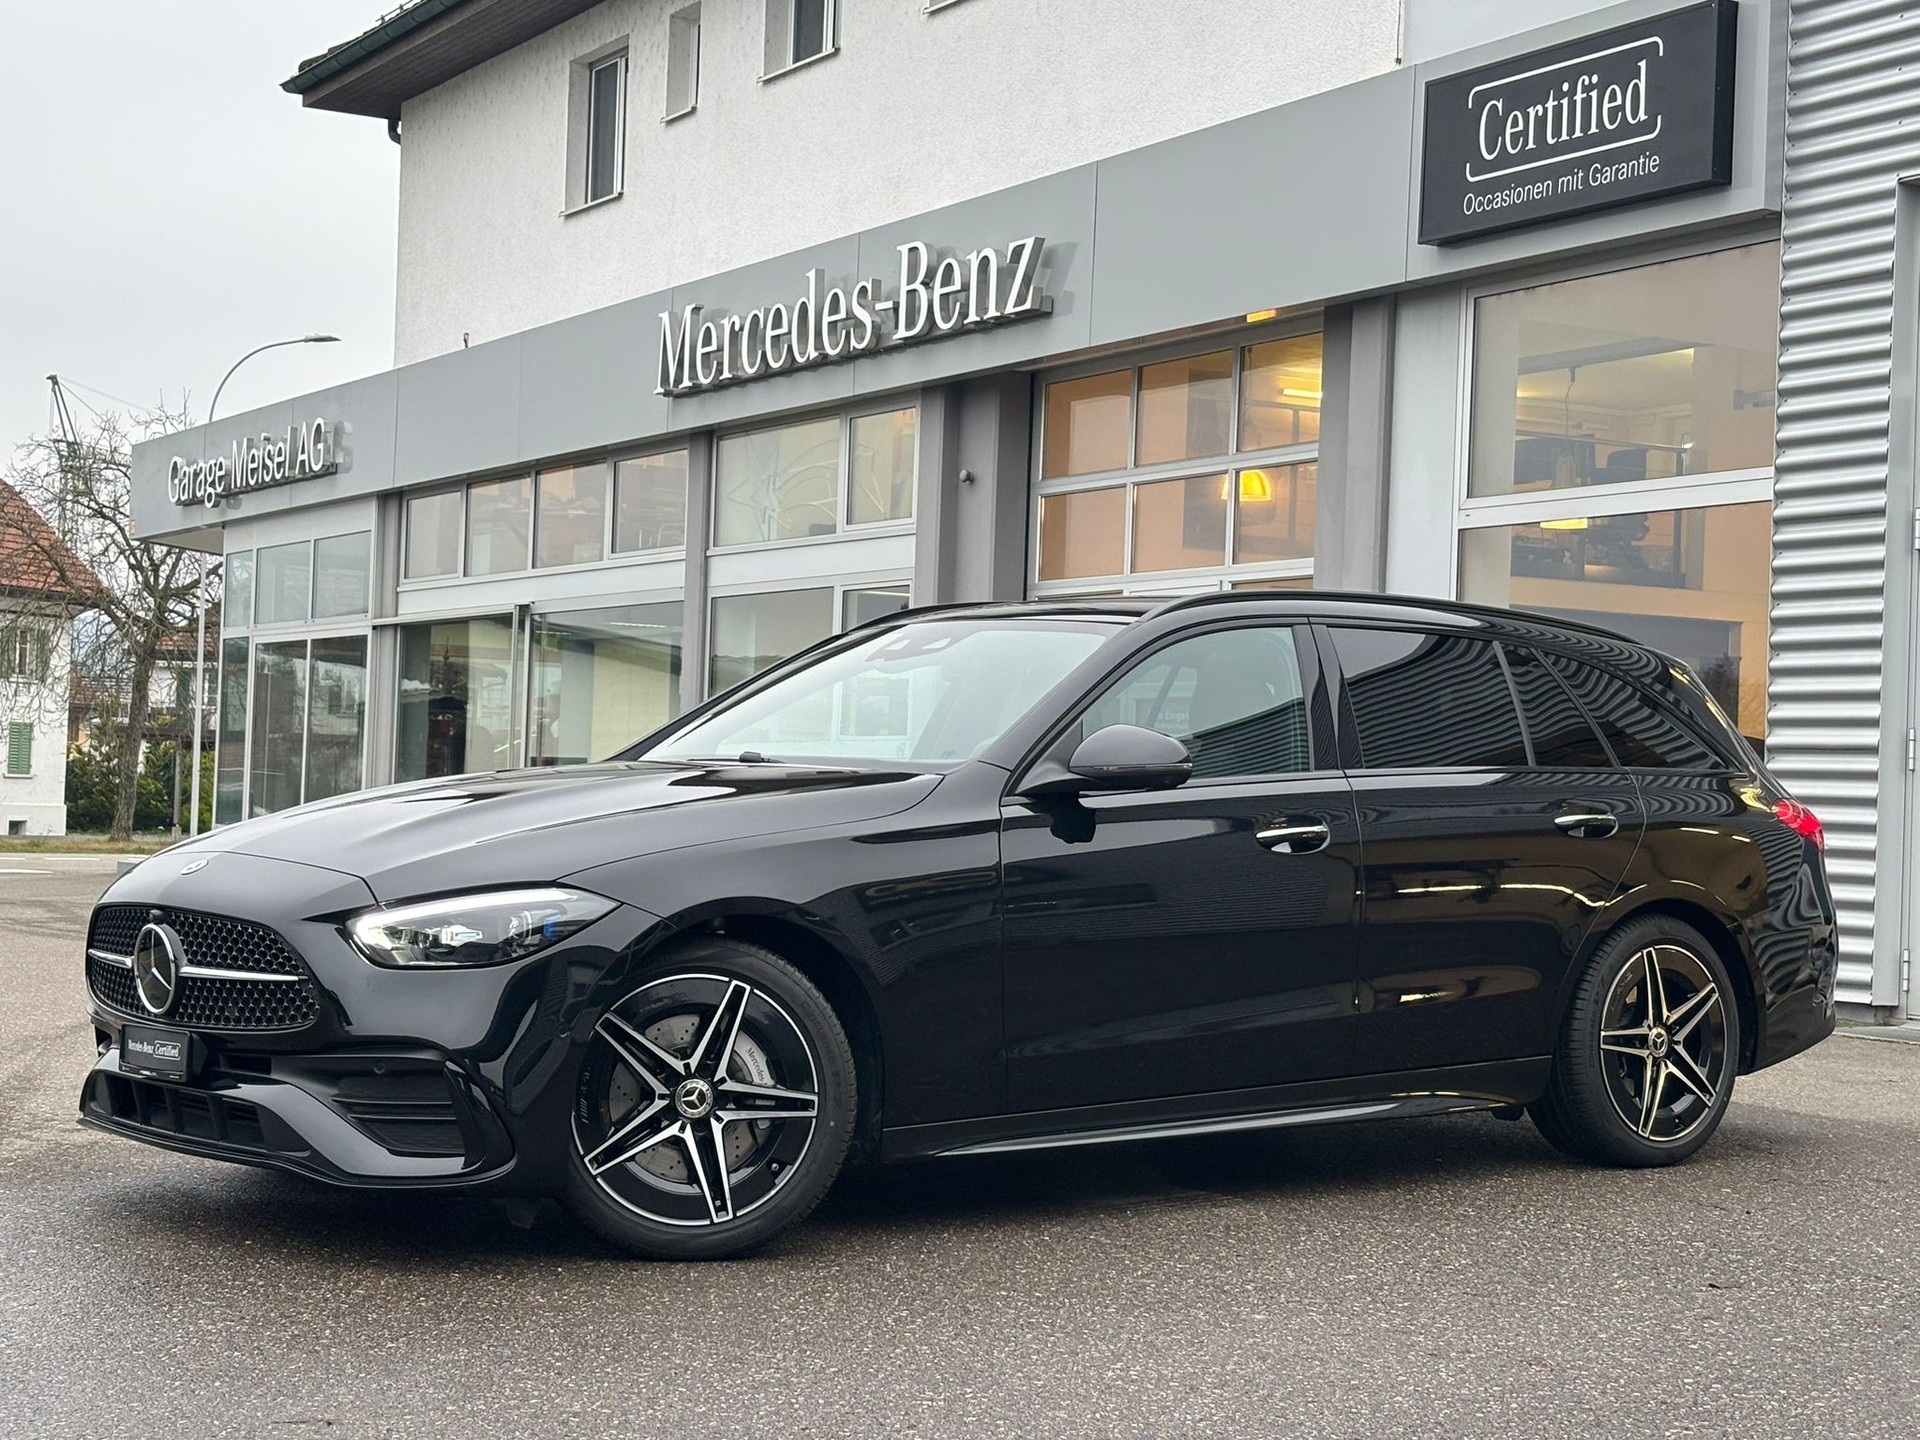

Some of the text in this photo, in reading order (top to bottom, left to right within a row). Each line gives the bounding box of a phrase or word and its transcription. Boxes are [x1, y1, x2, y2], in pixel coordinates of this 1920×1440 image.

[1479, 58, 1649, 161] Certified
[1463, 151, 1660, 215] Occasionen mit Garantie
[653, 236, 1041, 395] Mercedes-Benz
[168, 416, 326, 509] Garage Meisel AG
[155, 1044, 179, 1057] Certified
